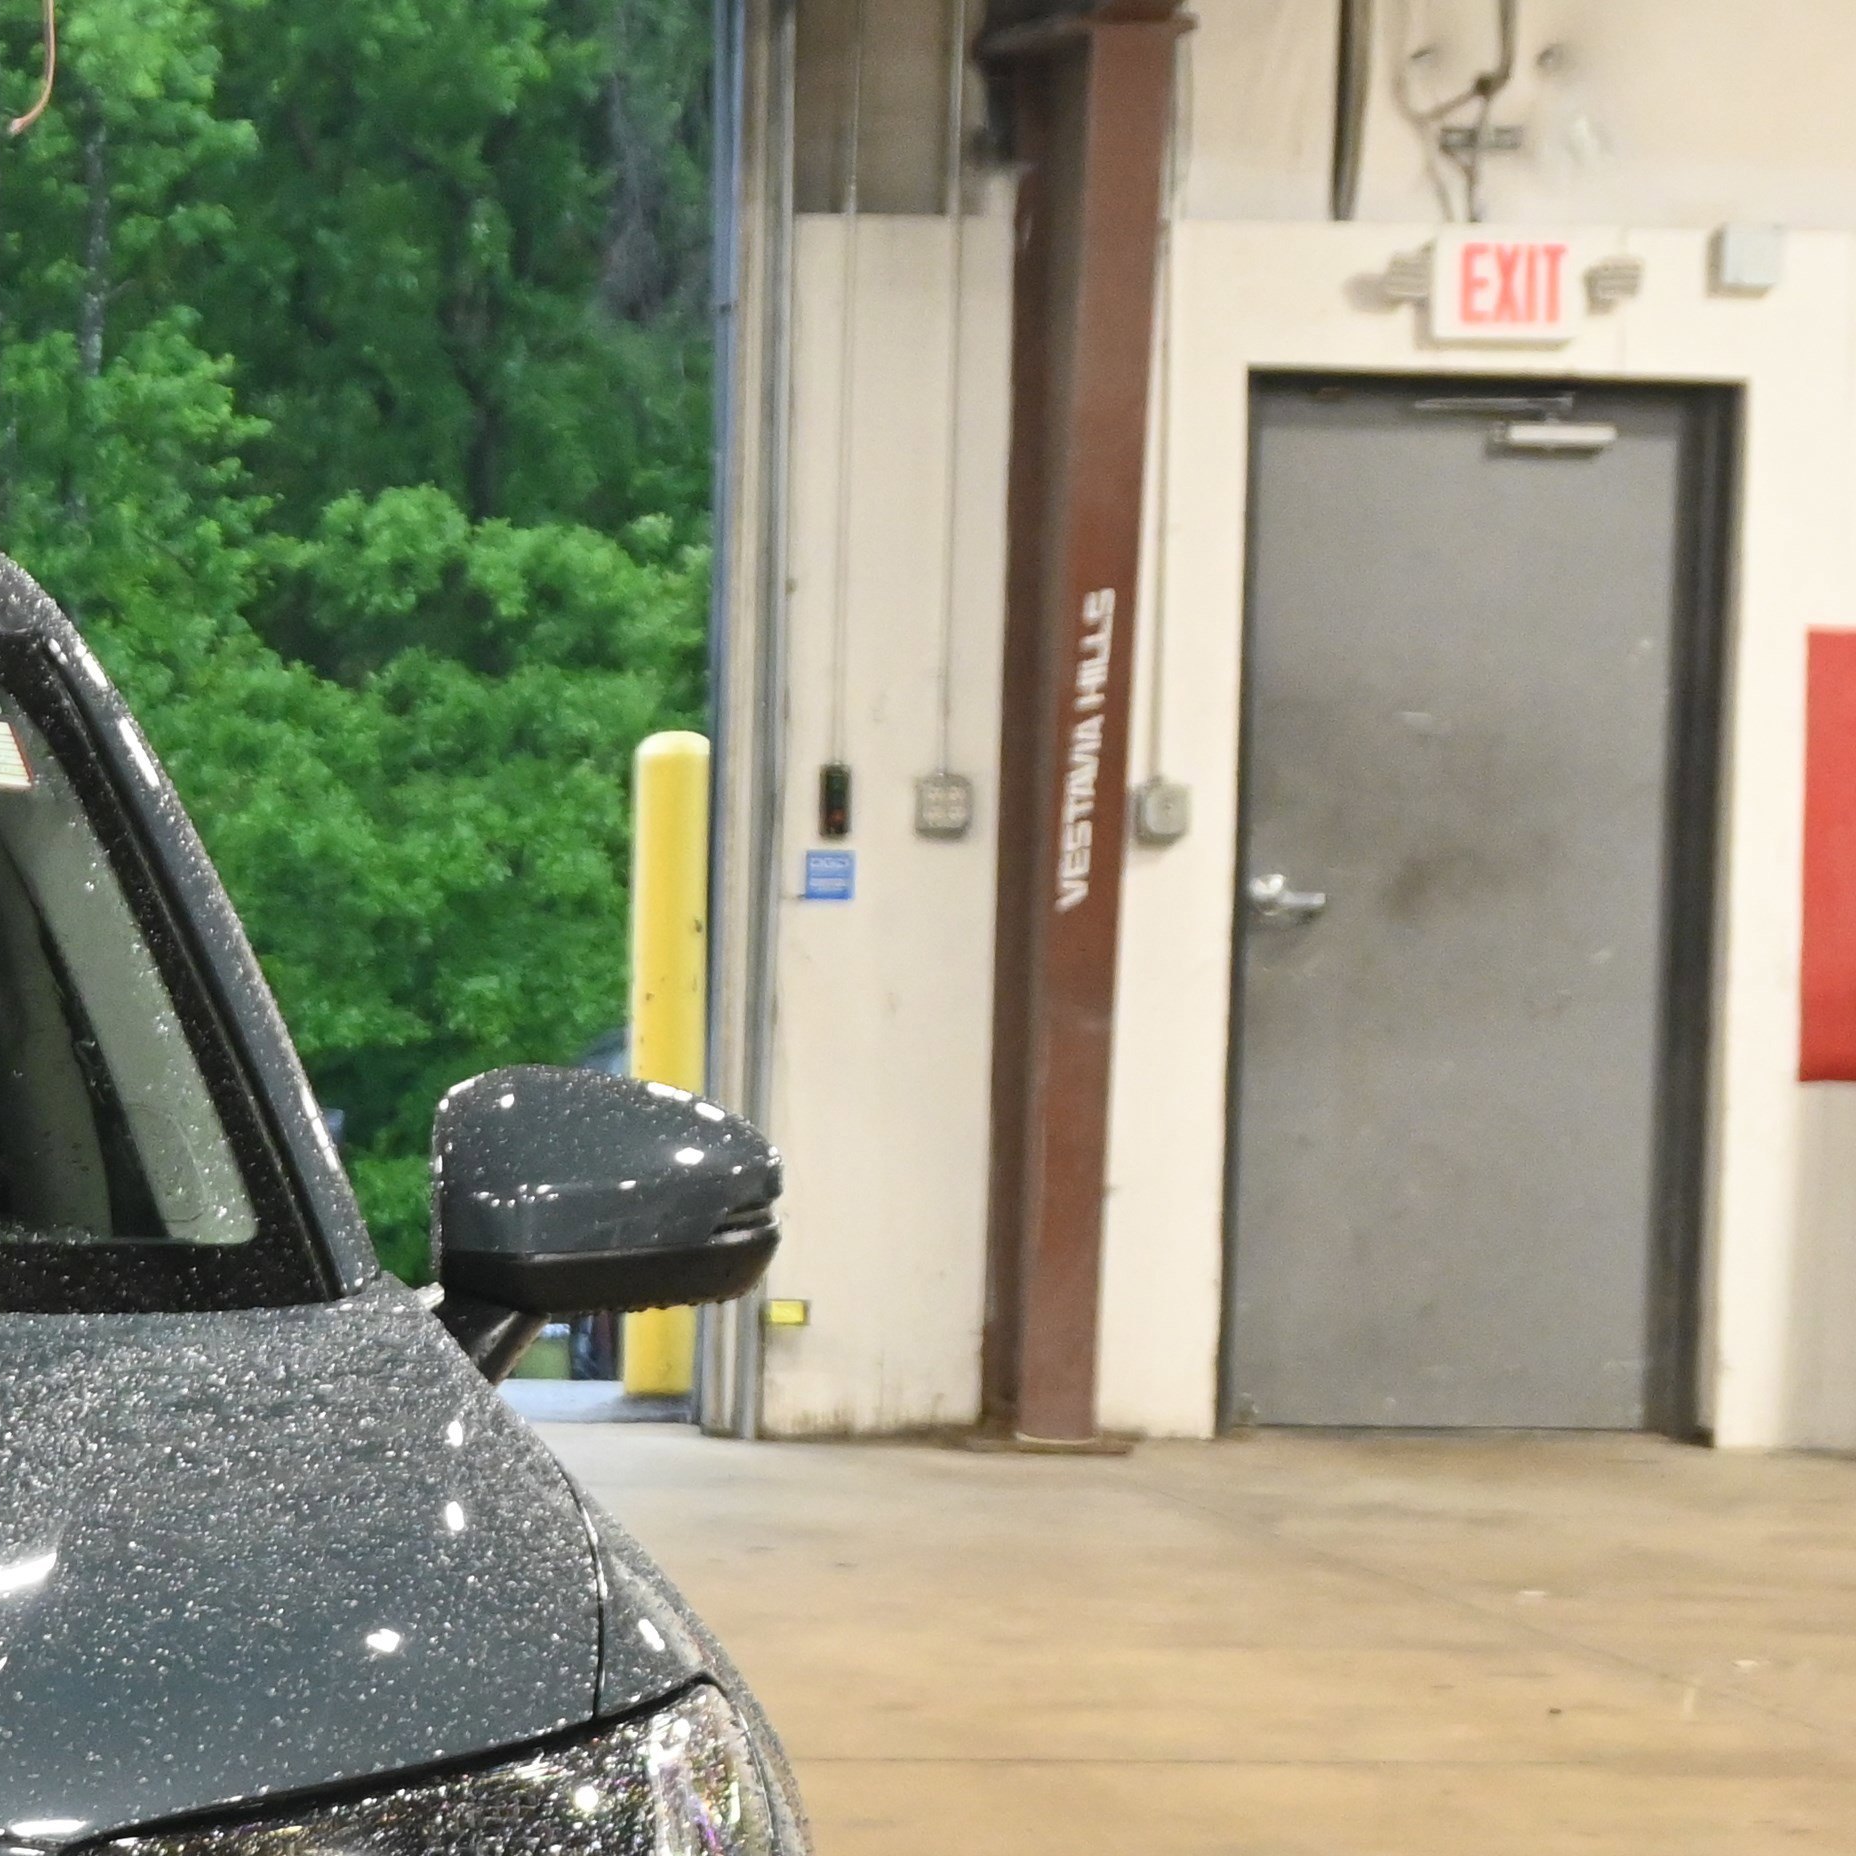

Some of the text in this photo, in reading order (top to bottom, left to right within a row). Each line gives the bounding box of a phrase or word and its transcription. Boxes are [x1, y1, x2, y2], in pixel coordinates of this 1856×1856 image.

[1460, 243, 1569, 324] EXIT
[1054, 587, 1117, 914] VESTAVIA HILLS
